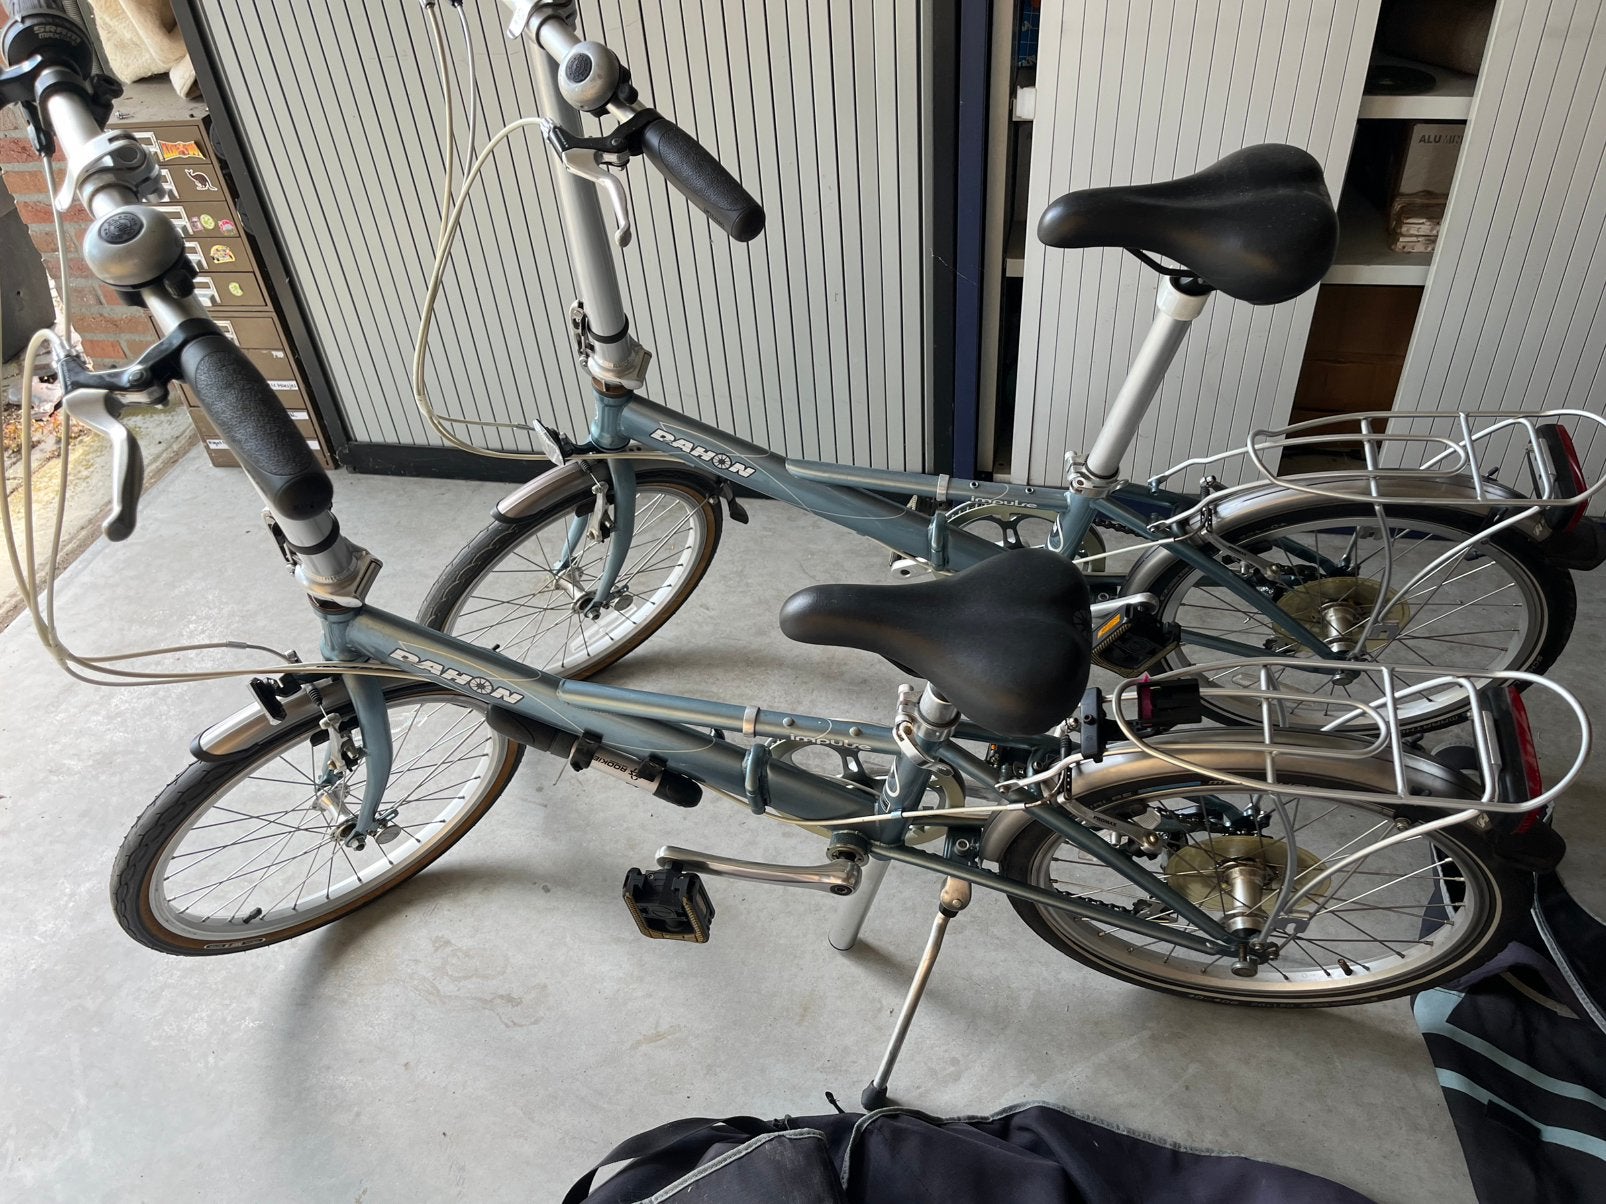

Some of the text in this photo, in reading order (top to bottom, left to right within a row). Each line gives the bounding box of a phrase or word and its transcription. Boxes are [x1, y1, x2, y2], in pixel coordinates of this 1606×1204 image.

[649, 428, 757, 478] DAHON
[970, 495, 1038, 509] impulse
[388, 648, 525, 704] DAHON
[790, 733, 872, 751] impulse
[593, 755, 628, 773] ROOKIE
